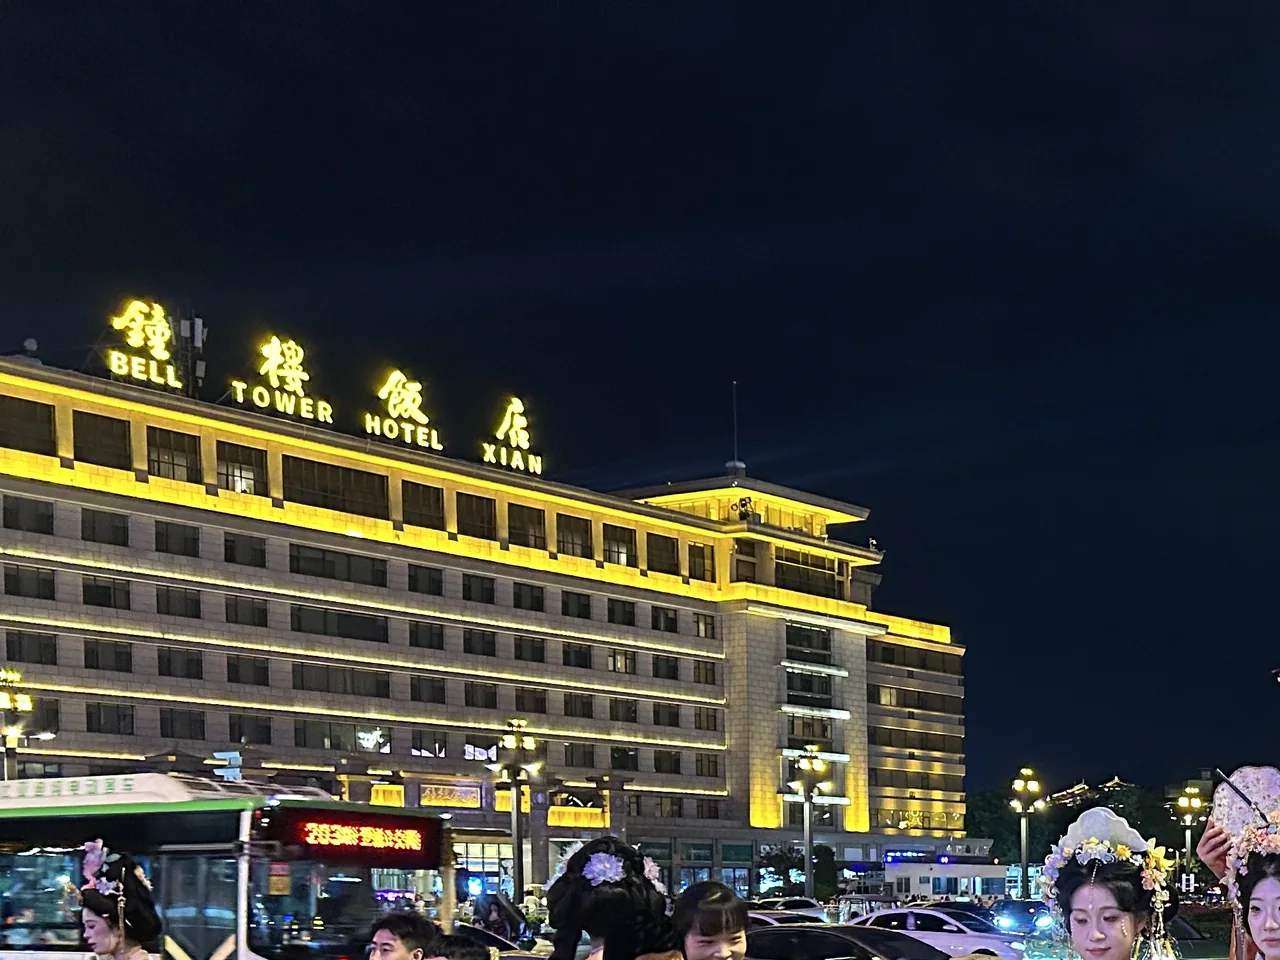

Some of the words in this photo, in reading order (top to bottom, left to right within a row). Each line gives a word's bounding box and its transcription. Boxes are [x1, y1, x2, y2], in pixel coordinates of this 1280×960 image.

[110, 350, 183, 389] BELL
[231, 380, 333, 424] TOWER
[364, 413, 444, 451] HOTEL
[482, 443, 542, 475] XIAN
